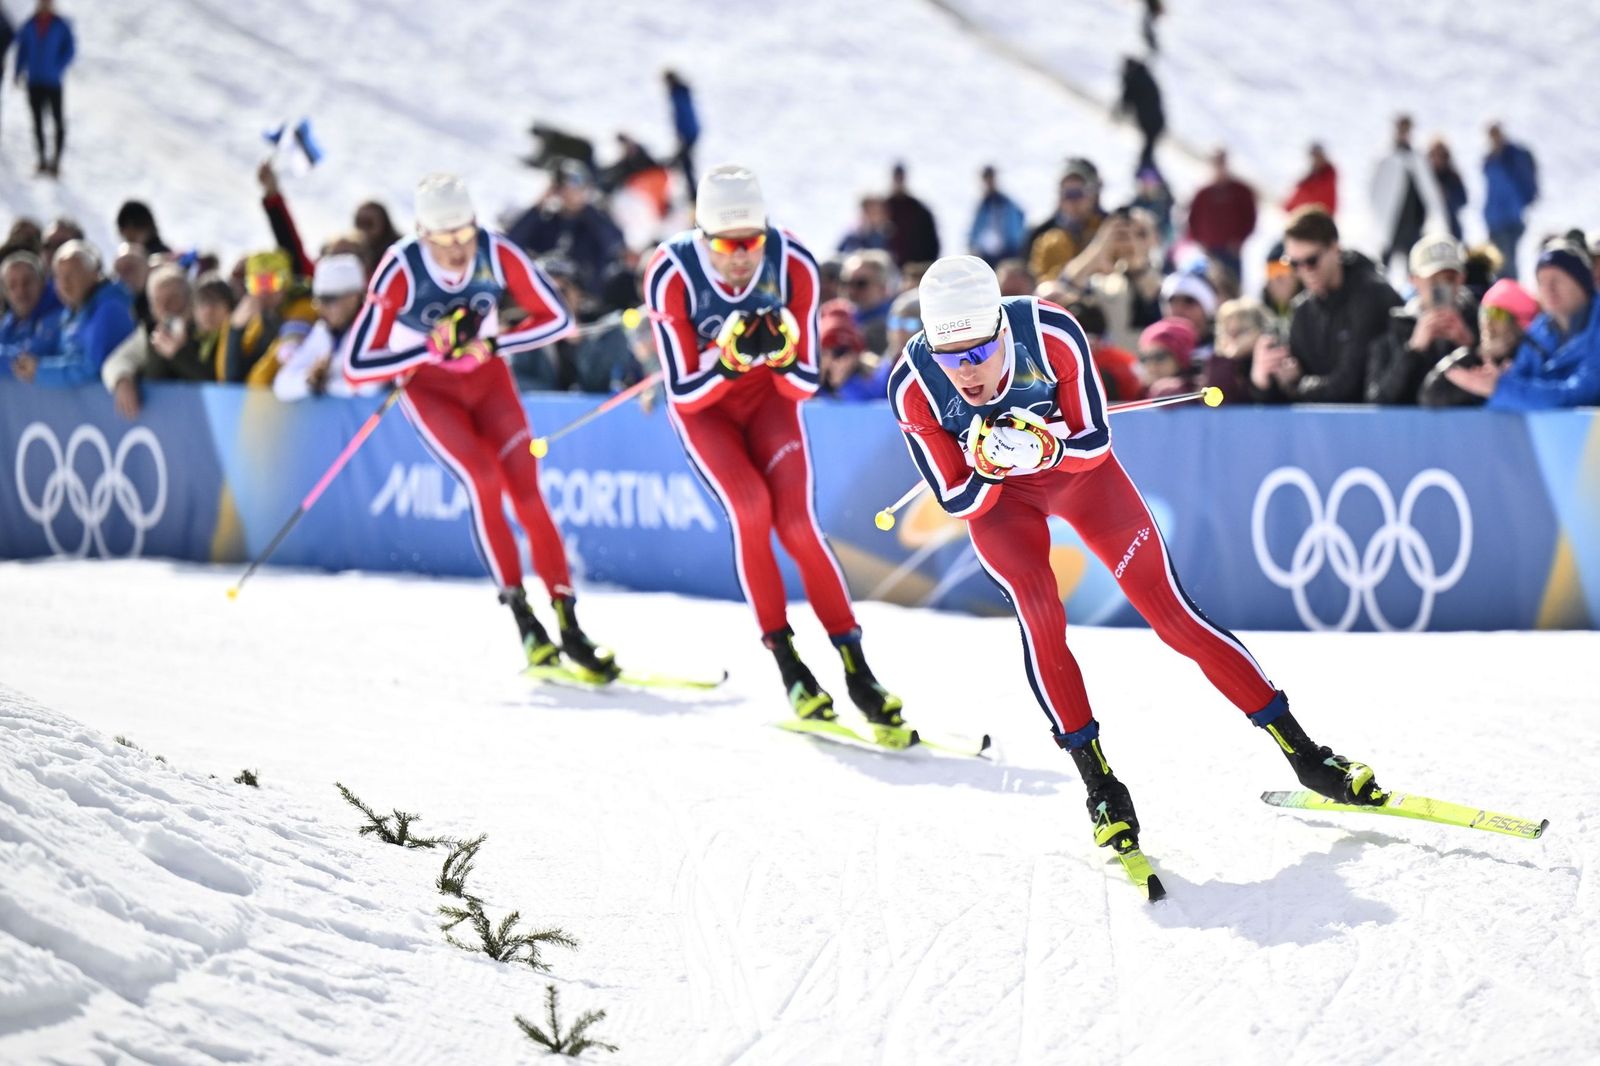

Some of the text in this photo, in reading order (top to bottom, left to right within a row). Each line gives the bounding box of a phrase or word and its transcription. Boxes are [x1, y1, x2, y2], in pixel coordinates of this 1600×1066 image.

[935, 318, 971, 332] NORGE
[1032, 427, 1053, 451] LEKI
[976, 444, 989, 470] LEKI
[369, 462, 717, 533] MILA CORTINA
[1114, 536, 1142, 579] CRAFT
